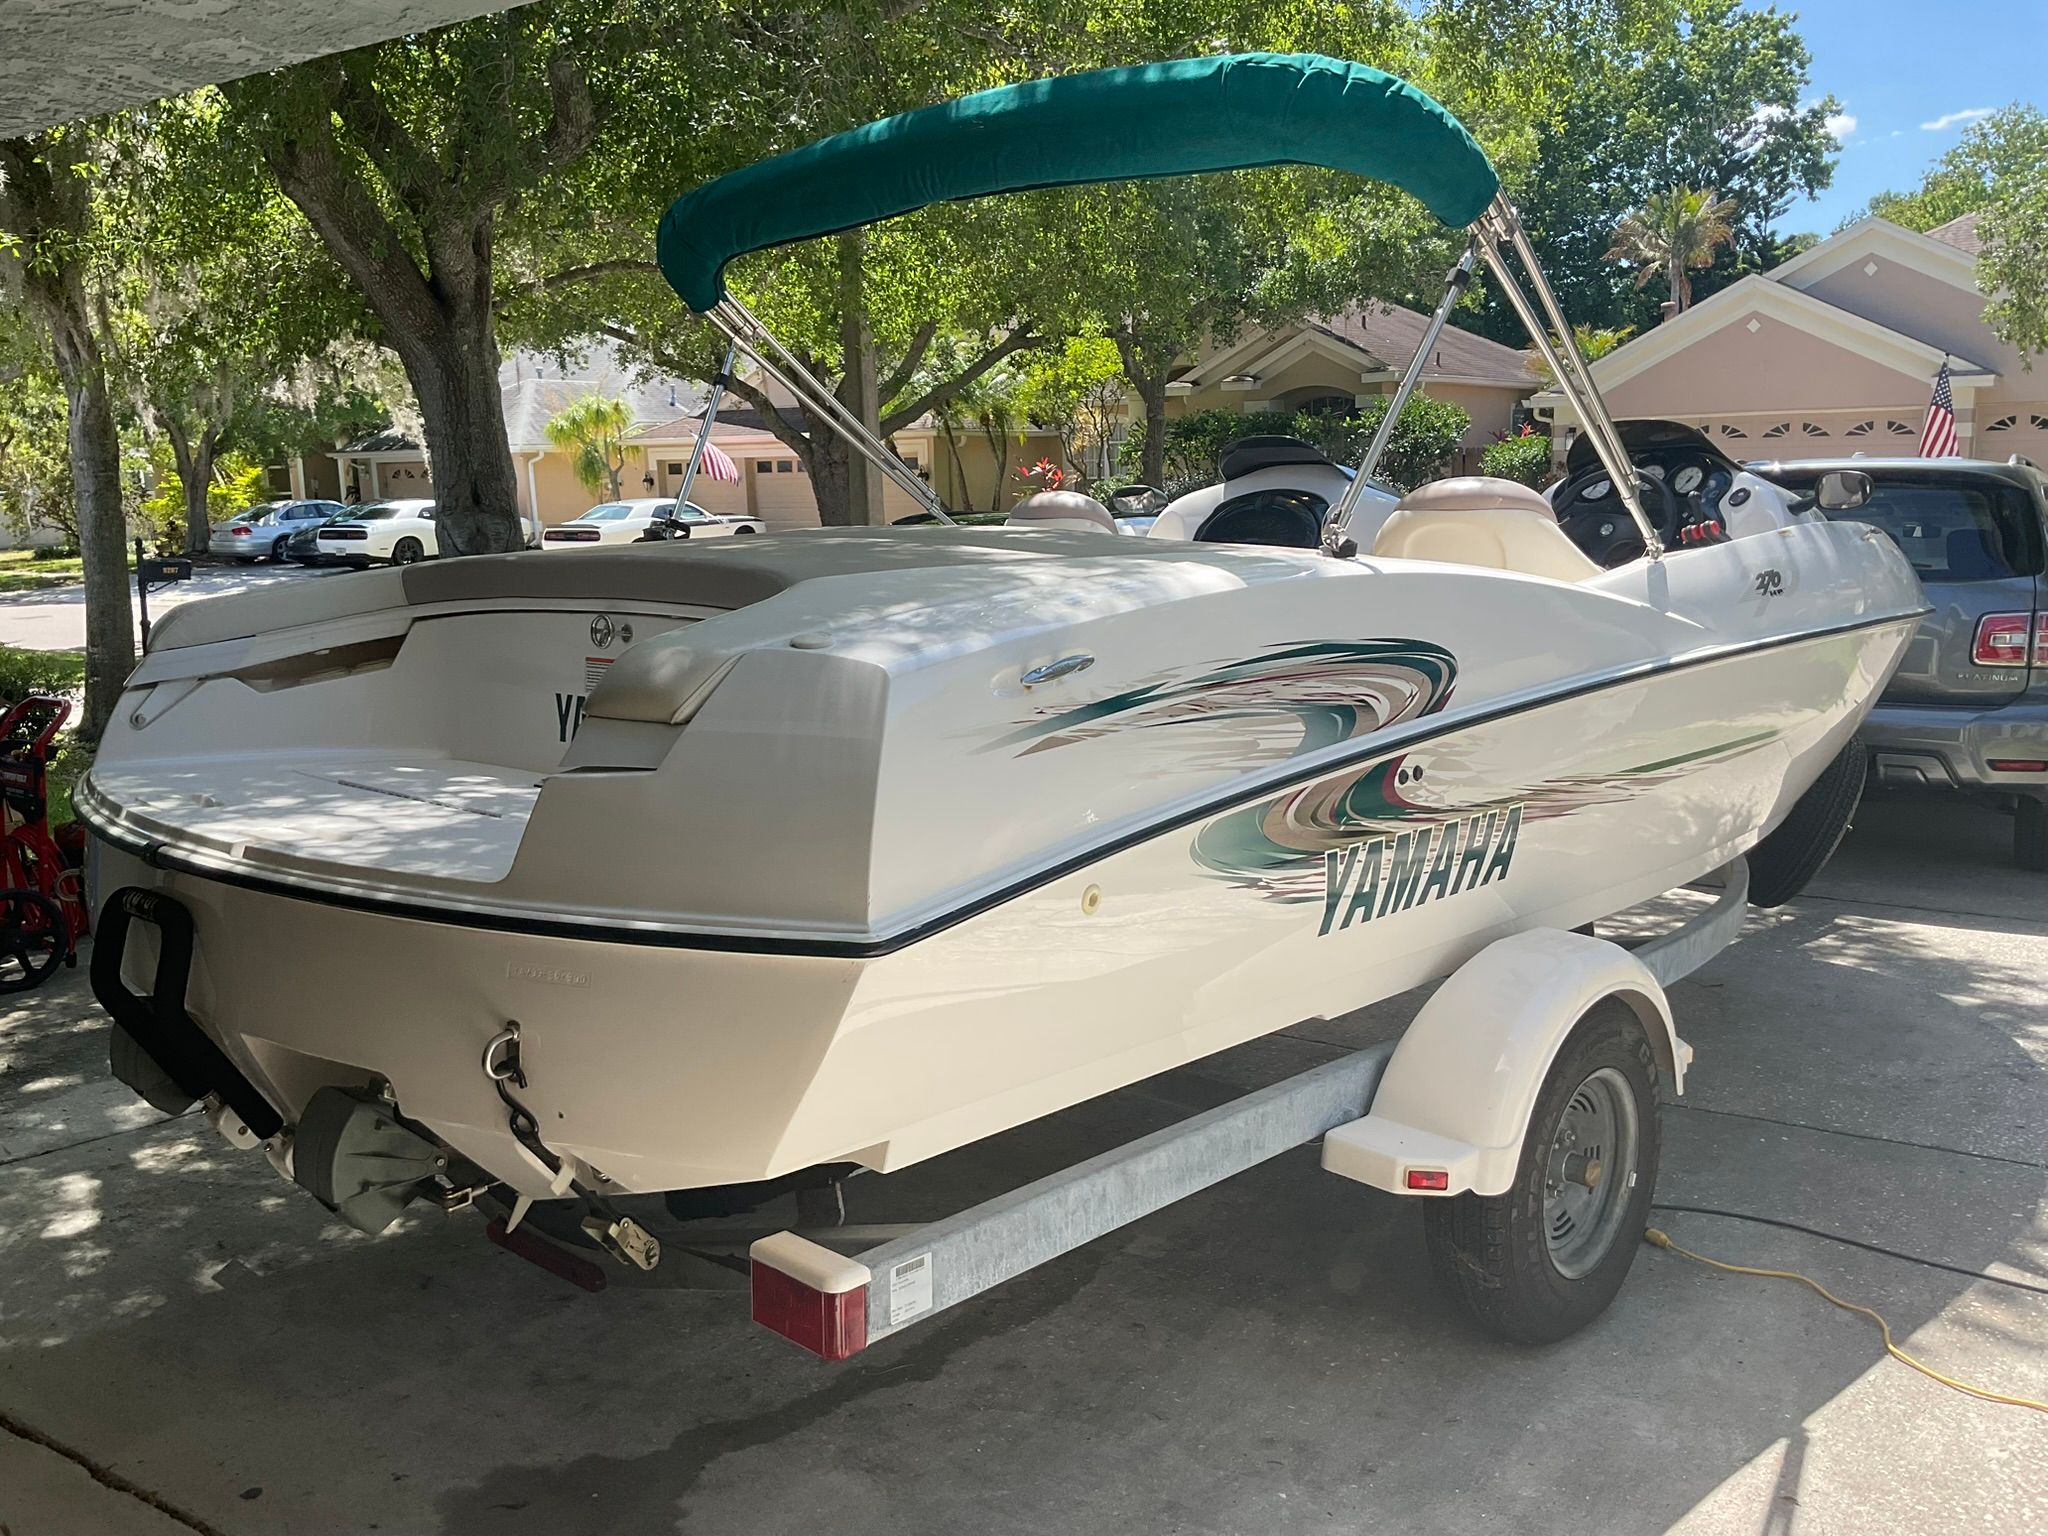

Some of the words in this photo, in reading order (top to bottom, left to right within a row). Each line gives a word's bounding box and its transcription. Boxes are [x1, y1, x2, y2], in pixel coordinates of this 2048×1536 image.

[1755, 569, 1781, 596] 270
[1957, 673, 2018, 682] PLATINUM
[1318, 803, 1524, 937] YAMAHA
